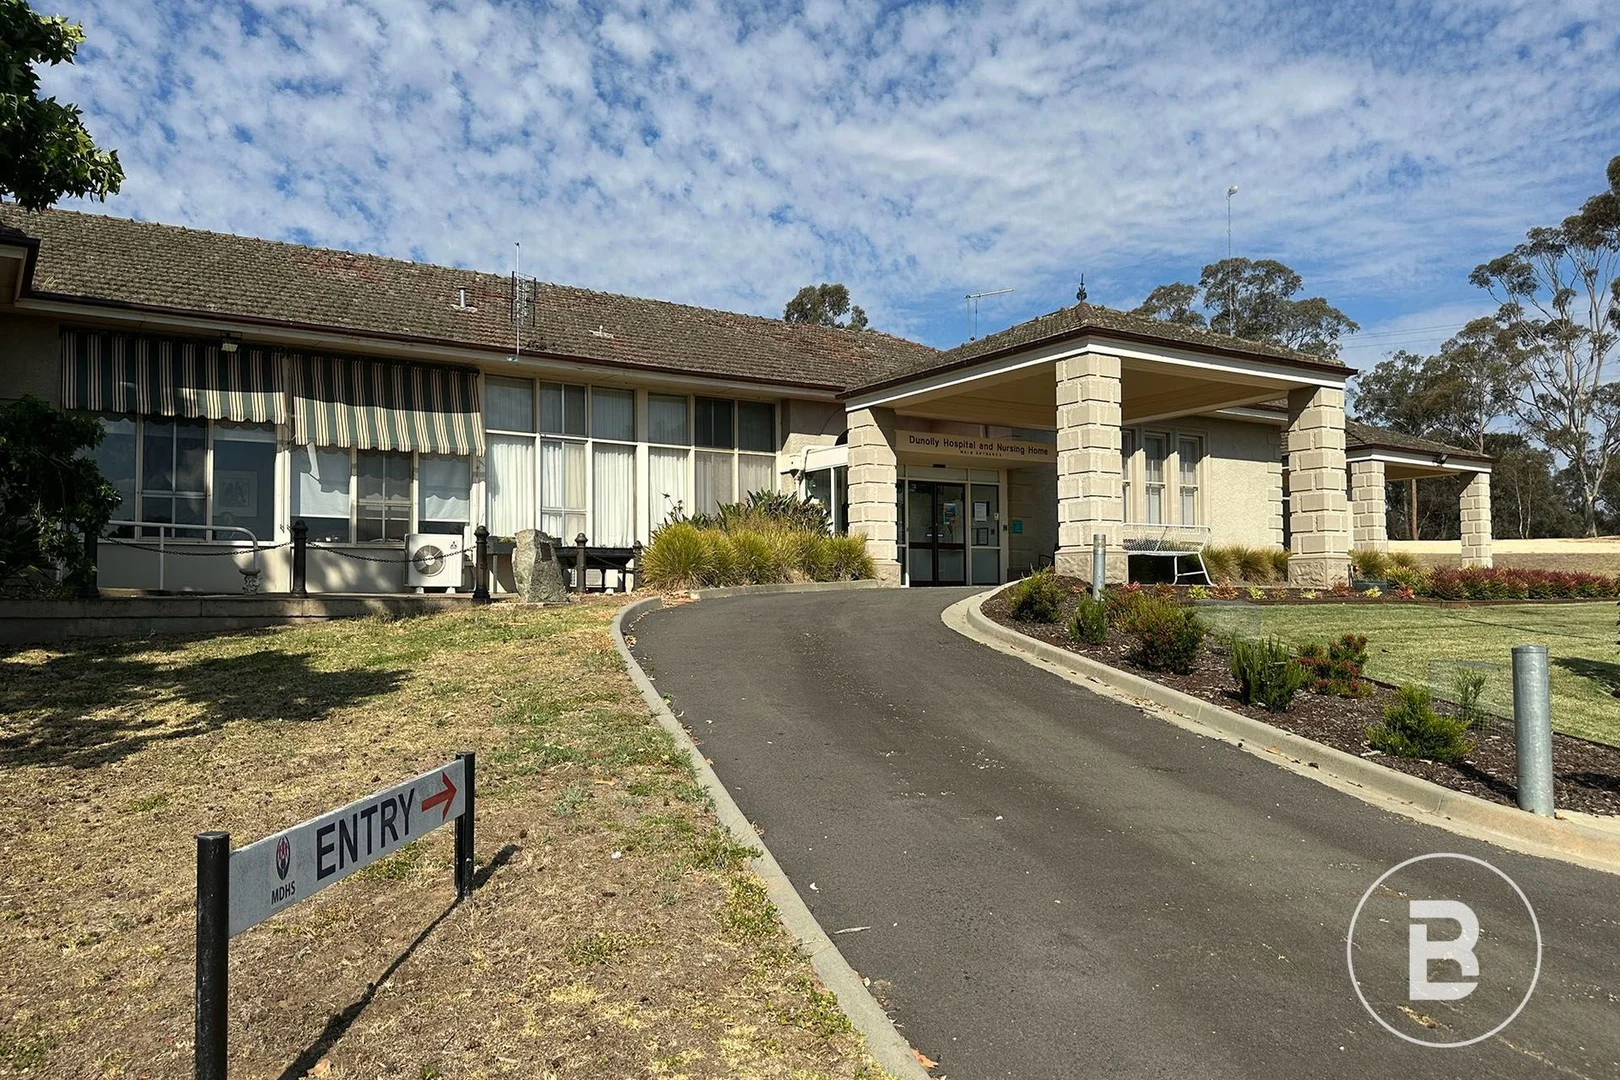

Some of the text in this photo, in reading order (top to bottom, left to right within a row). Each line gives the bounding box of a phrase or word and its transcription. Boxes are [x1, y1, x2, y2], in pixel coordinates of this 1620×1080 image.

[909, 435, 1048, 455] Dunolly Hospital and Nursing Home
[316, 788, 415, 881] ENTRY
[271, 881, 296, 905] MDHS
